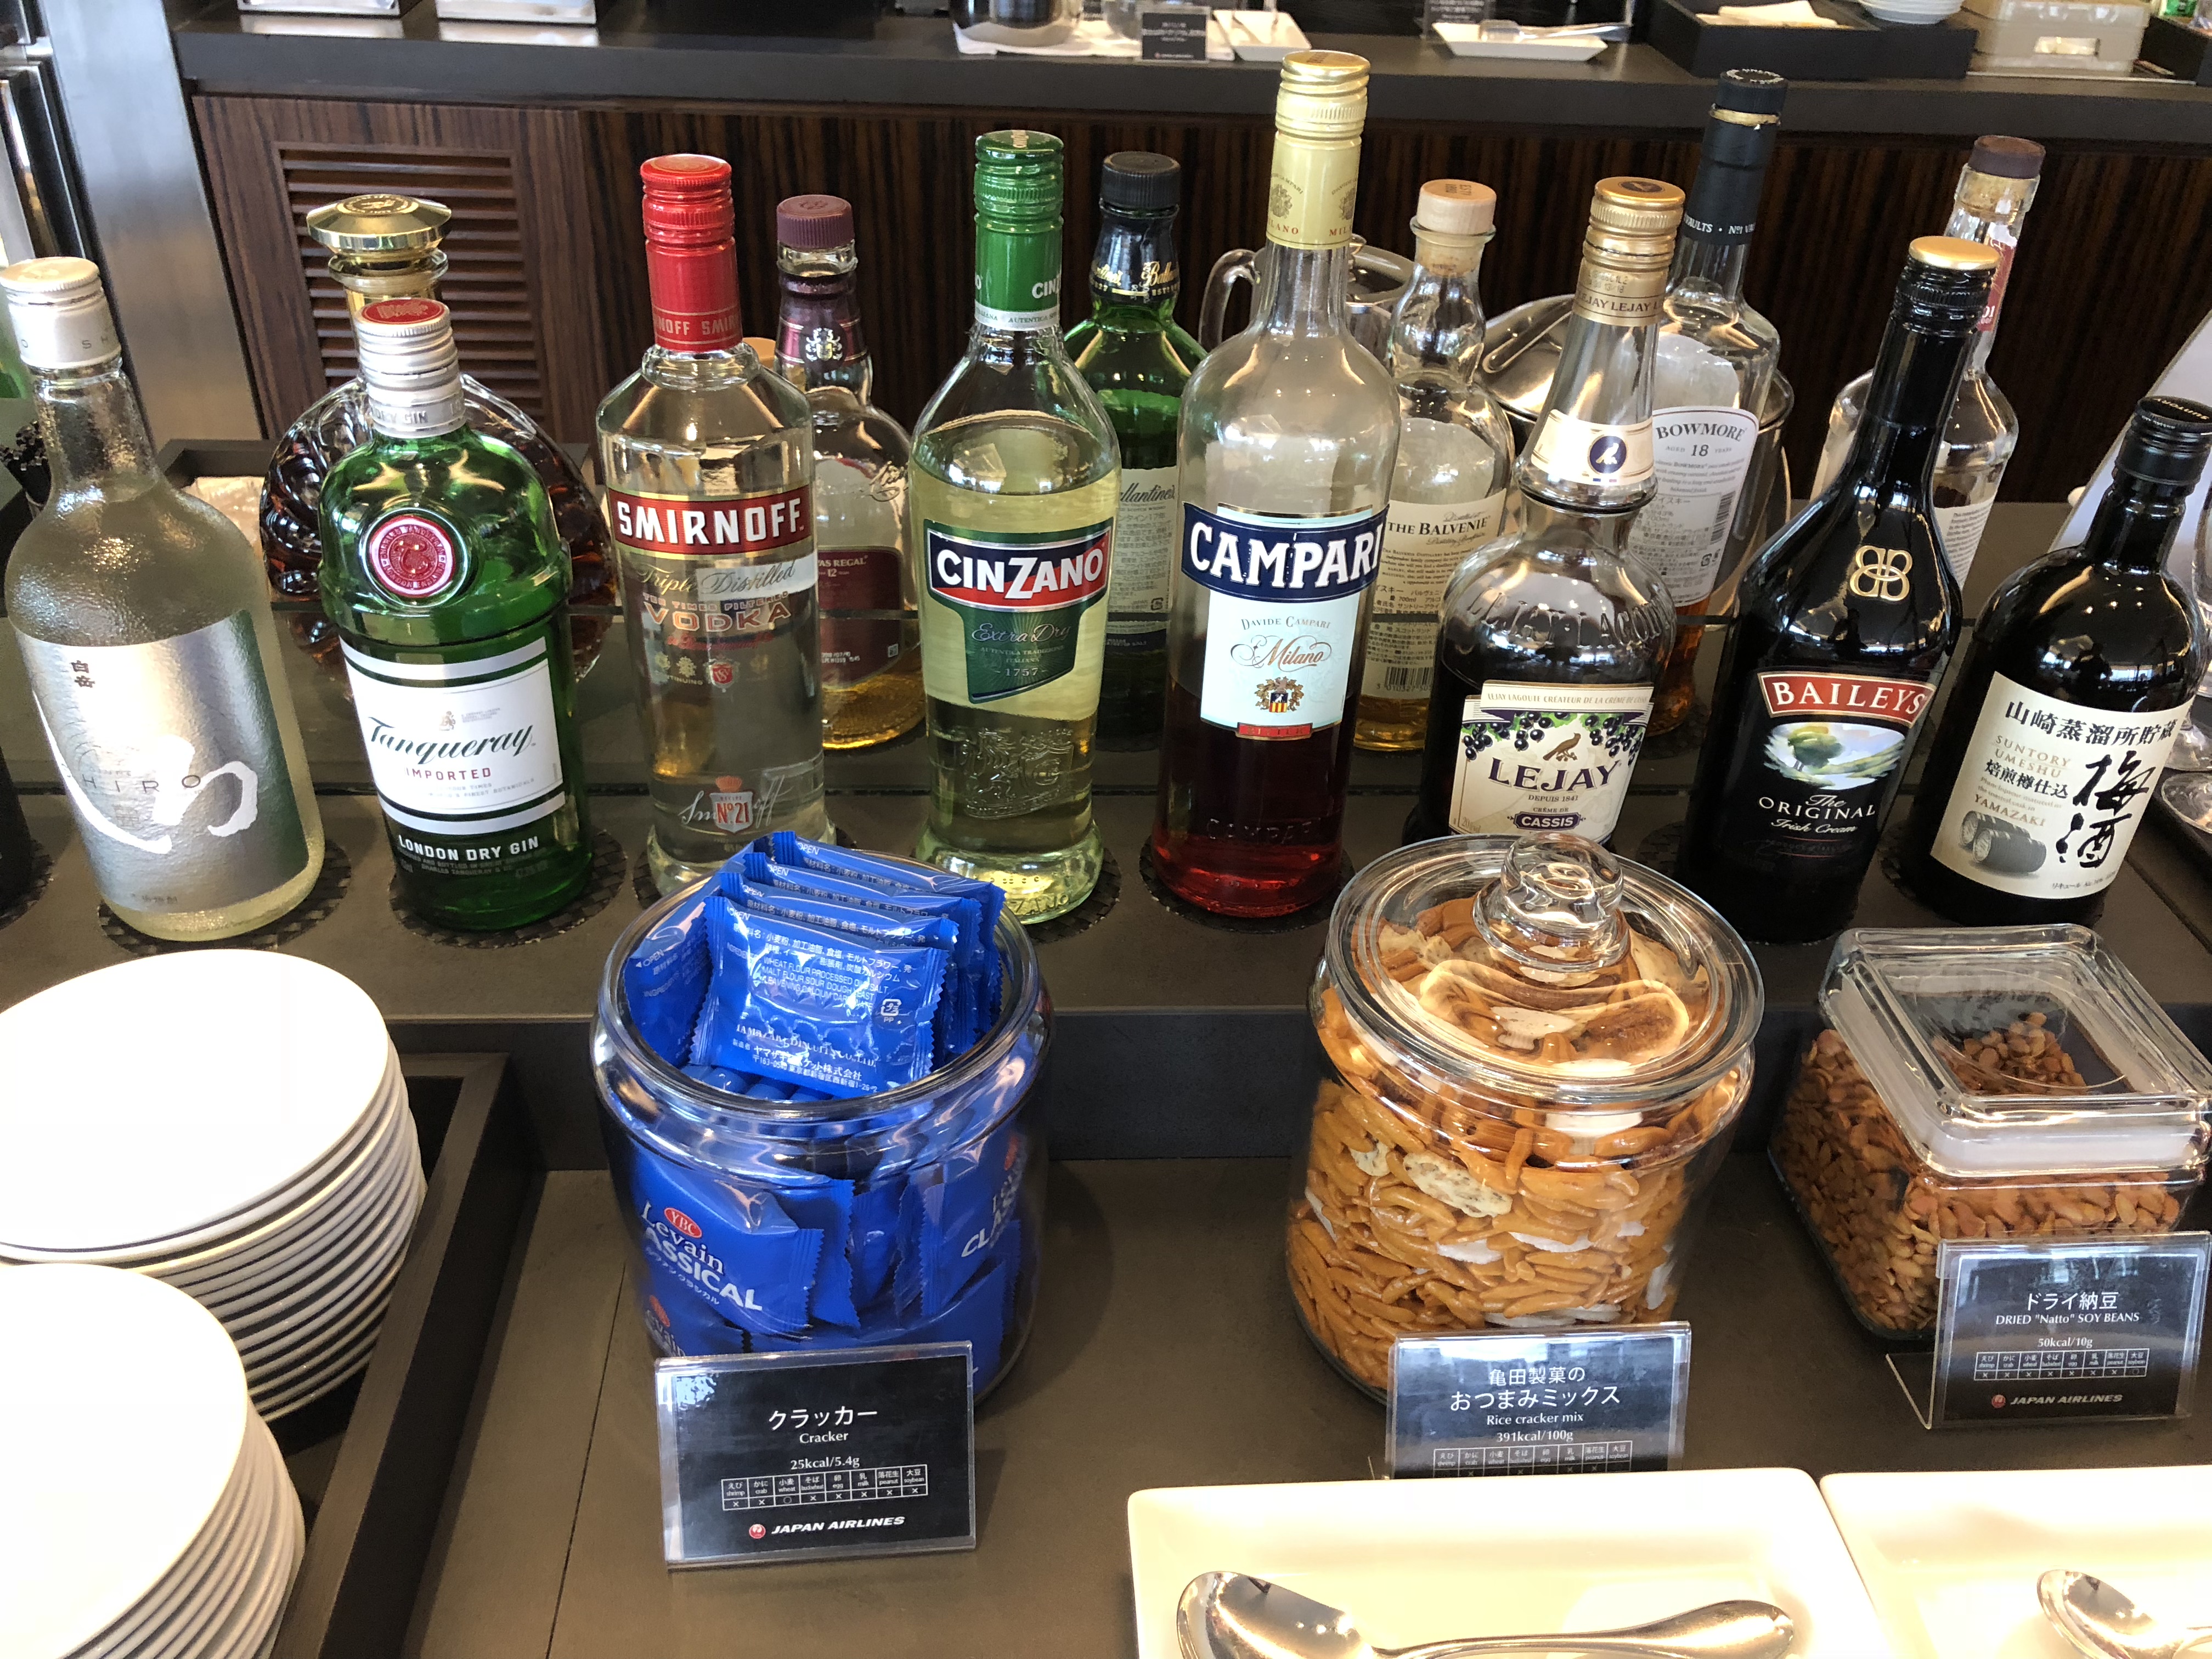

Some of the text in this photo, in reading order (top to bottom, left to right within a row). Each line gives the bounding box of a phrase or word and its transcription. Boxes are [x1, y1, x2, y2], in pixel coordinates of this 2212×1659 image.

[1611, 302, 1651, 312] LEJAY
[404, 411, 428, 424] GIN
[1656, 423, 1746, 442] BOWMORE
[1691, 444, 1709, 457] 18
[617, 498, 801, 546] SMIRNOFF
[1388, 517, 1488, 535] THE BALVENIE
[833, 557, 867, 567] REGAL
[1190, 521, 1384, 589] CAMPARI
[637, 559, 797, 596] Triple Distilled
[827, 568, 837, 577] 12
[937, 548, 1104, 599] CINZANO
[672, 600, 718, 612] TIMES
[724, 590, 788, 611] FILTERED
[643, 601, 792, 632] VODKA
[1241, 616, 1332, 630] DAVIDE CAMPARI
[971, 623, 1071, 642] Extra Dry
[1245, 635, 1332, 672] Milano
[71, 659, 95, 689] 白岳
[1005, 668, 1039, 676] 1757
[1543, 695, 1581, 704] CRÉATEUR
[1771, 681, 1927, 715] BAILEYS
[2005, 701, 2179, 747] 山崎蒸溜所貯蔵
[368, 716, 533, 765] Tanqueray
[1995, 735, 2071, 767] SUNTORY
[405, 765, 492, 781] IMPORTED
[1995, 748, 2062, 778] UMESHU
[1488, 757, 1621, 793] LEJAY
[1985, 759, 2068, 799] 焙煎樽仕込
[1528, 794, 1579, 803] DEPUIS 1841
[1758, 797, 1876, 820] ORIGINAL
[1805, 794, 1847, 808] The
[1974, 793, 2047, 827] YAMAZAKI
[2056, 750, 2157, 869] 梅酒
[1521, 815, 1575, 828] CASSIS
[1771, 818, 1858, 836] Irish Cream
[398, 834, 459, 861] LONDON
[467, 845, 501, 861] DRY
[510, 836, 539, 855] GIN
[797, 842, 820, 855] OPEN
[642, 949, 665, 967] OPEN
[762, 966, 782, 978] MALT
[782, 970, 805, 983] FLOUR
[806, 976, 825, 987] SOUR
[826, 981, 853, 995] DOUGH
[764, 956, 787, 969] WHEAT
[788, 961, 811, 975] FLOUR
[811, 967, 854, 985] PROCESSED
[870, 981, 888, 994] SALT
[670, 1210, 698, 1235] YBC
[641, 1200, 725, 1275] Levain
[2027, 1291, 2119, 1311] ドライ納豆
[1996, 1313, 2032, 1325] DRIED
[2077, 1313, 2101, 1323] SOY
[2103, 1312, 2140, 1323] BEANS
[2037, 1336, 2094, 1350] 50kcal/10g
[1489, 1366, 1585, 1386] 亀田製菓の
[1450, 1385, 1621, 1412] おつまみミックス
[2011, 1394, 2123, 1405] JAPAN AIRLINES
[768, 1405, 878, 1431] クラッカー
[1486, 1412, 1584, 1426] Rice cracker mix
[799, 1431, 849, 1444] Cracker
[1496, 1429, 1573, 1444] 391kcal/100g
[790, 1455, 860, 1471] 25kcal/5.4g
[726, 1489, 746, 1498] shrimp
[878, 1479, 899, 1487] peanut
[727, 1482, 743, 1490] えび
[778, 1478, 795, 1487] 小麦
[805, 1475, 820, 1483] そば
[859, 1472, 867, 1481] 乳
[878, 1470, 900, 1479] 落花生
[906, 1468, 922, 1477] 大豆
[771, 1516, 905, 1535] JAPAN AIRLINES
